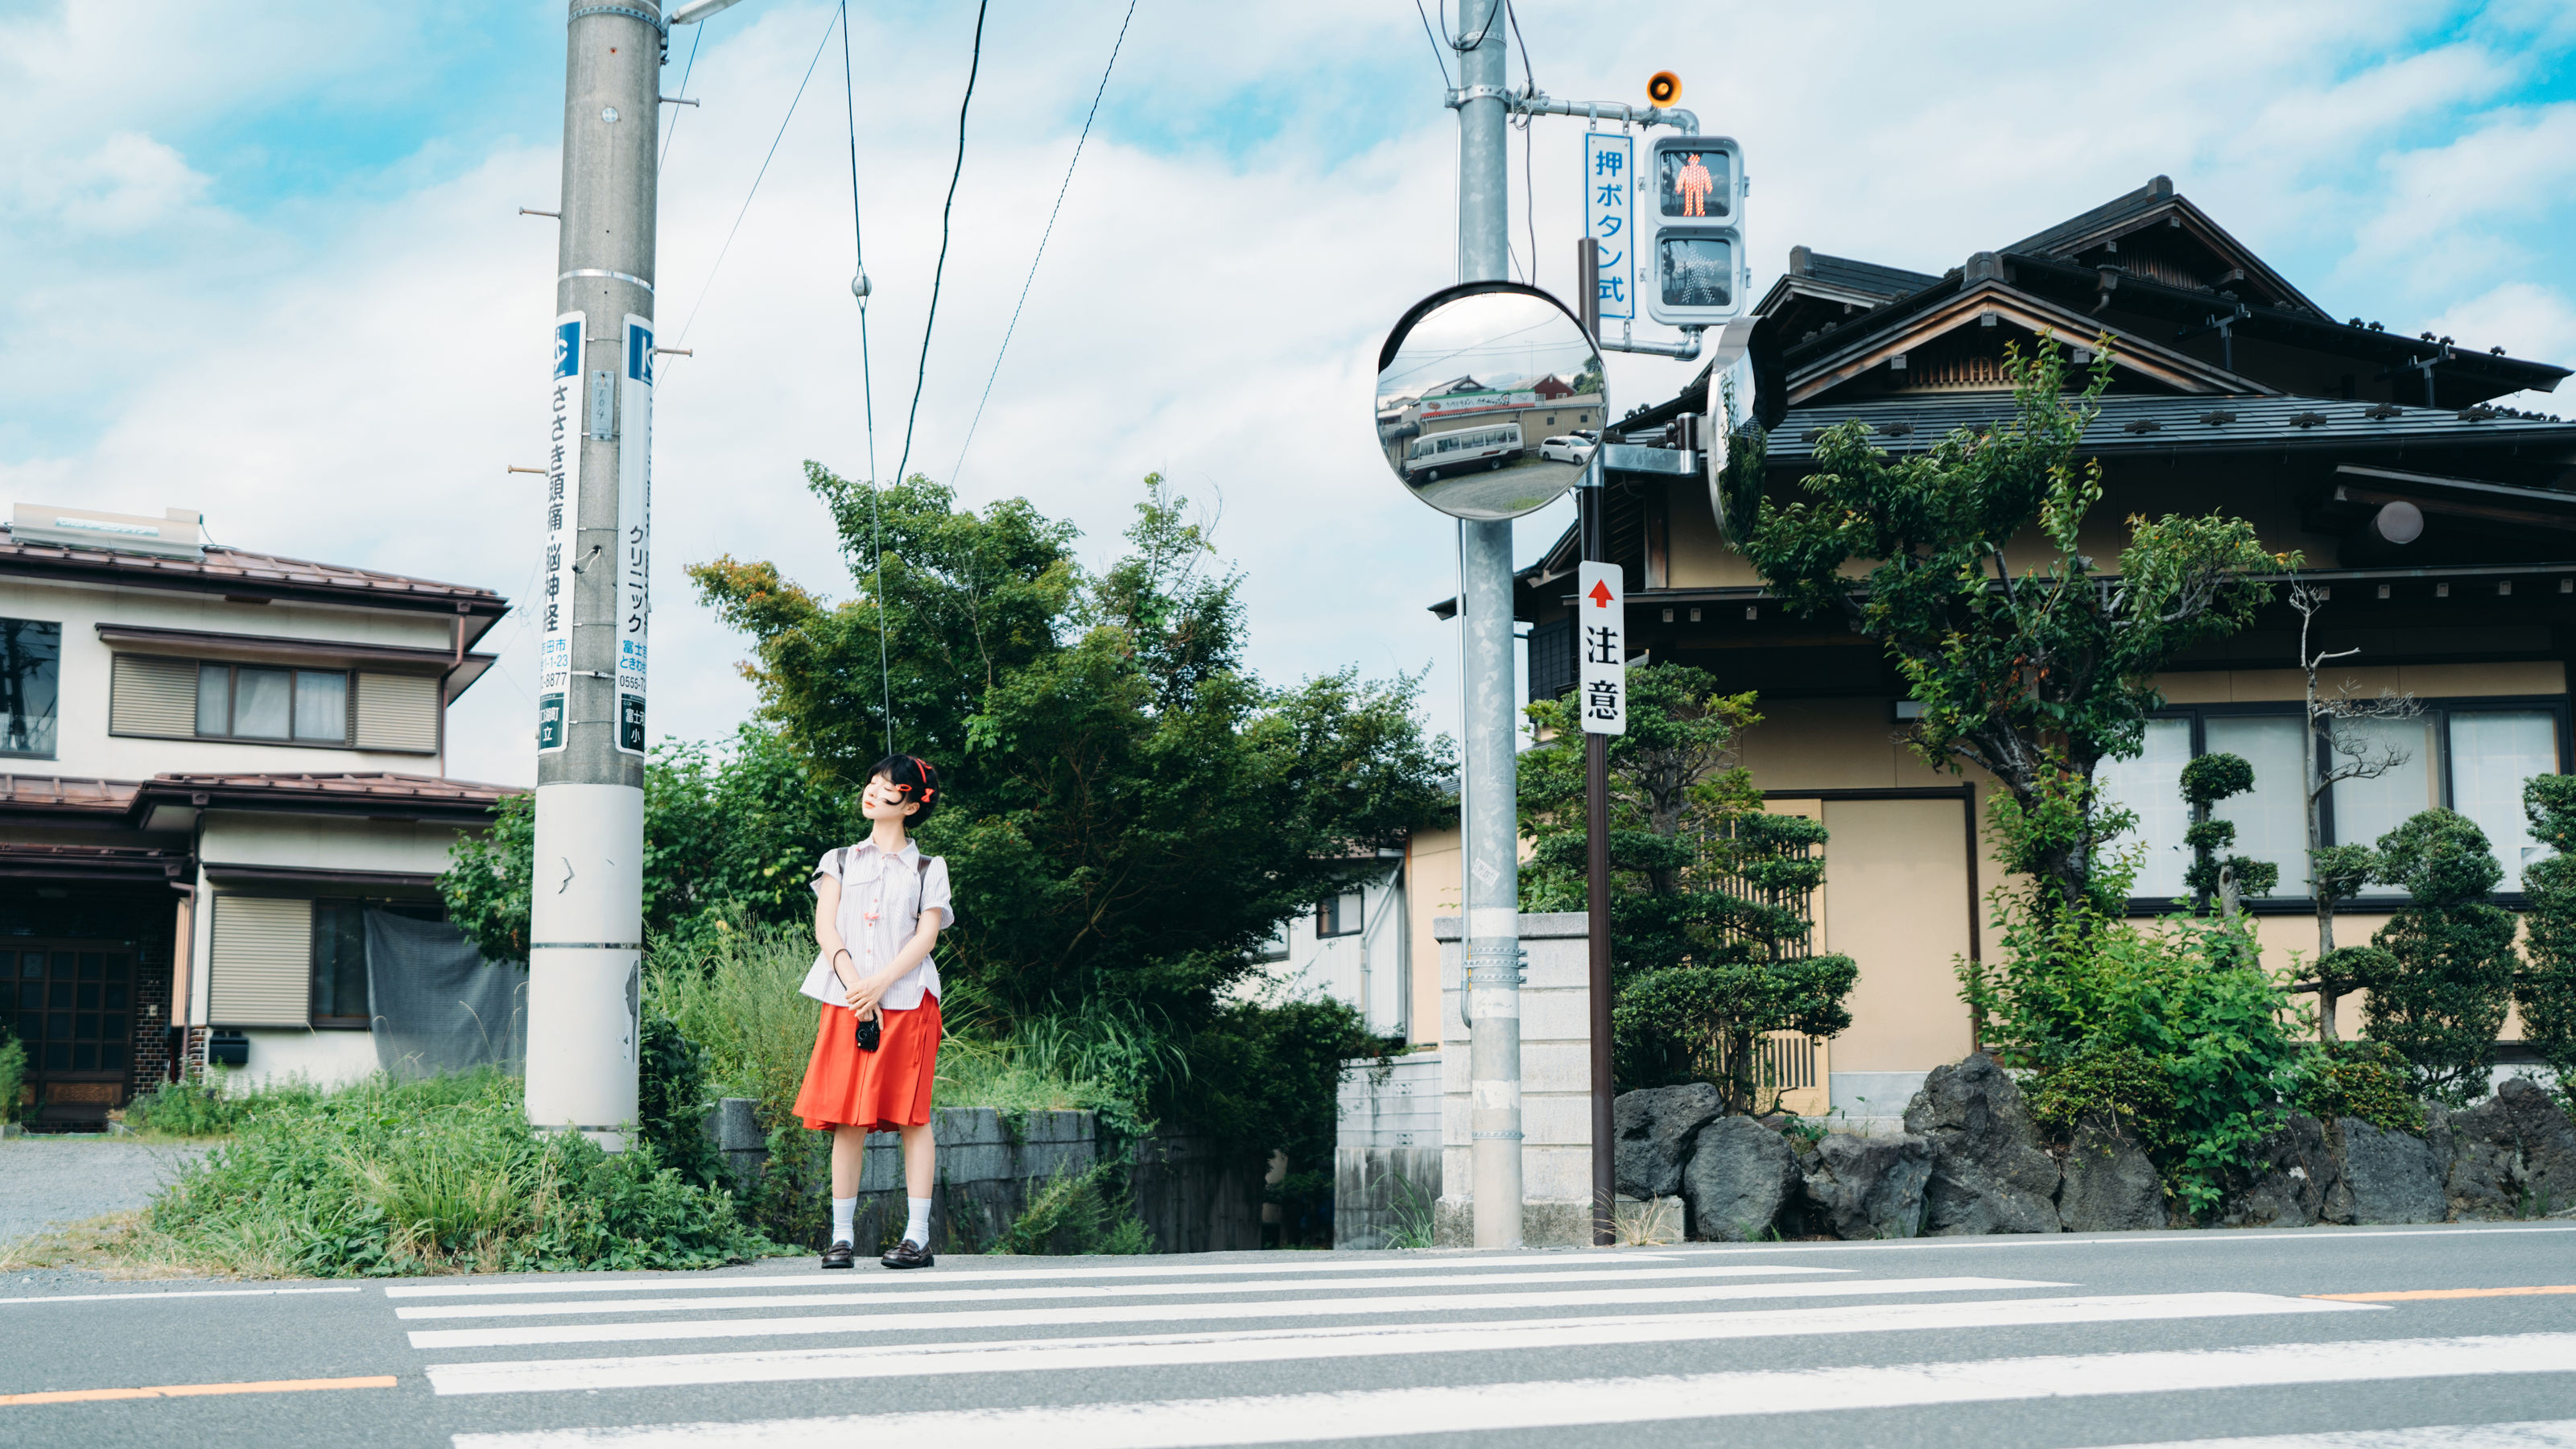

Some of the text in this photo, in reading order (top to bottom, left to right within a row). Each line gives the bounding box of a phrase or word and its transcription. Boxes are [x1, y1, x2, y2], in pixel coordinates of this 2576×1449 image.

[1596, 151, 1624, 303] 押ボタン式
[628, 525, 643, 633] クリニック
[1586, 625, 1620, 720] 注意
[630, 728, 641, 743] 小
